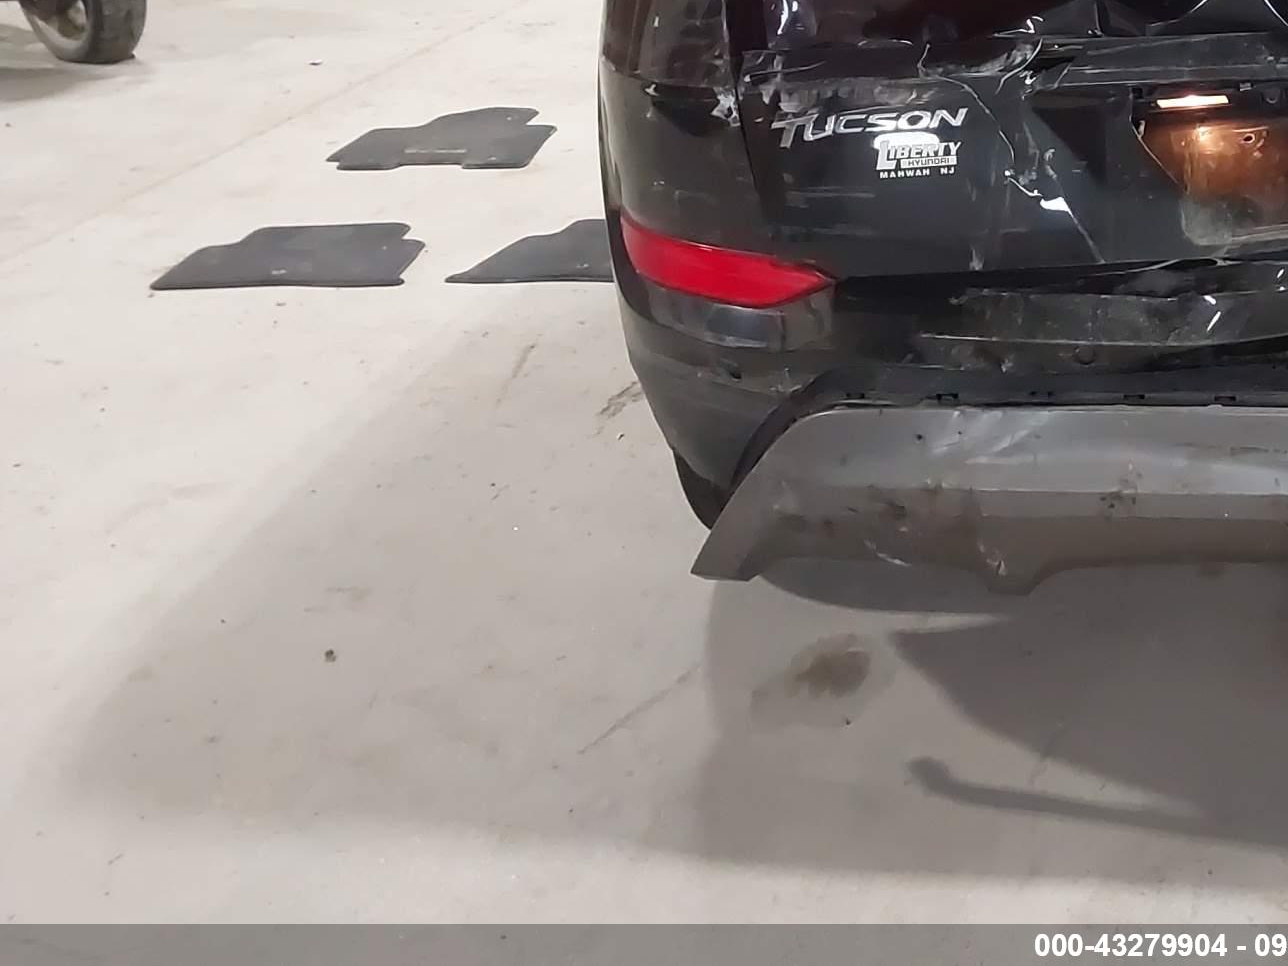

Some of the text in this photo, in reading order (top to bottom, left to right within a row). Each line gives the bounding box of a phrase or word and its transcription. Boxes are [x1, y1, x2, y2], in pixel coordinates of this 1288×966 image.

[771, 108, 969, 148] TUCSON
[876, 140, 961, 170] LIBERTY
[907, 157, 950, 167] HYUNDAI
[880, 167, 955, 179] MAHWAH NJ
